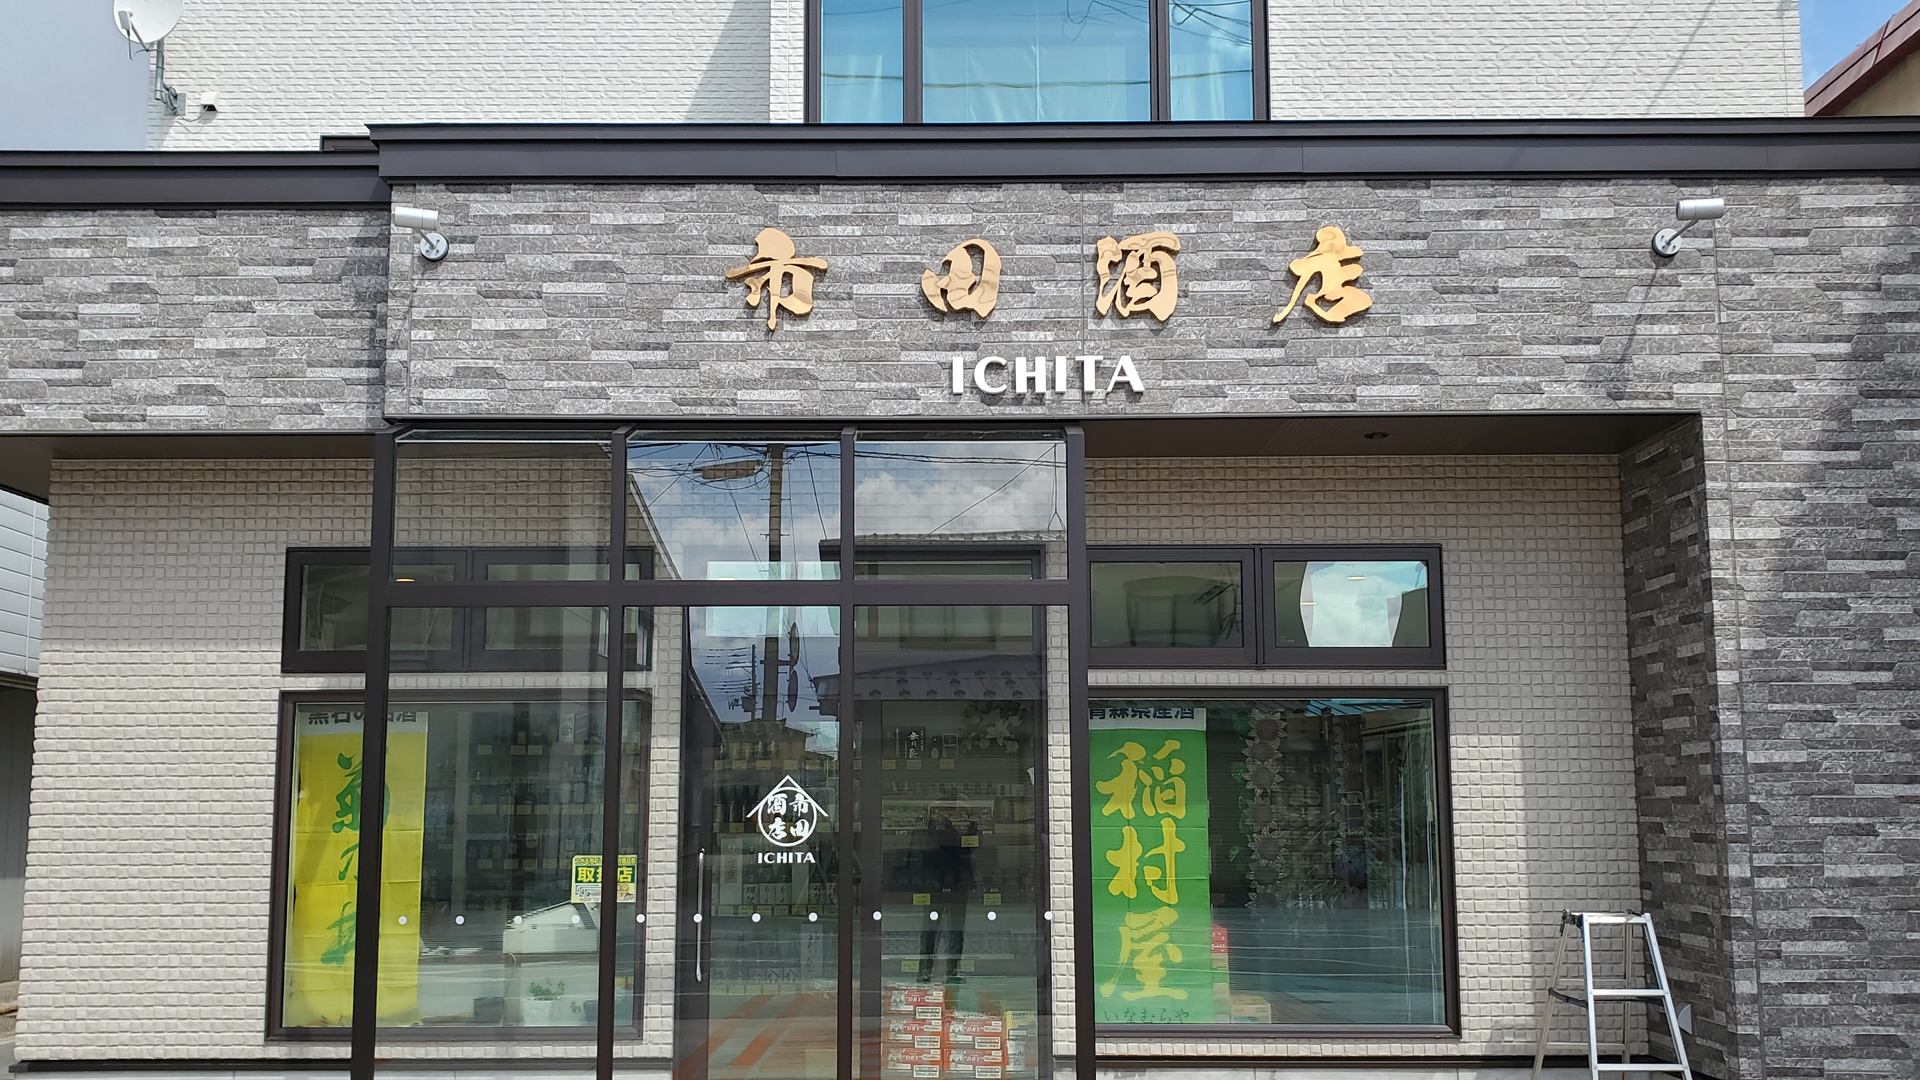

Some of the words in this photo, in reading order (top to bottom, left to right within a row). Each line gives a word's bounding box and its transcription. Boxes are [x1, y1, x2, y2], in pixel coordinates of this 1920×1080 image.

[726, 226, 1373, 332] 市田酒店
[951, 354, 1145, 396] ICHITA
[308, 711, 416, 725] 黒石の酒
[757, 852, 816, 864] ICHITA
[1095, 738, 1189, 1001] 稲村屋
